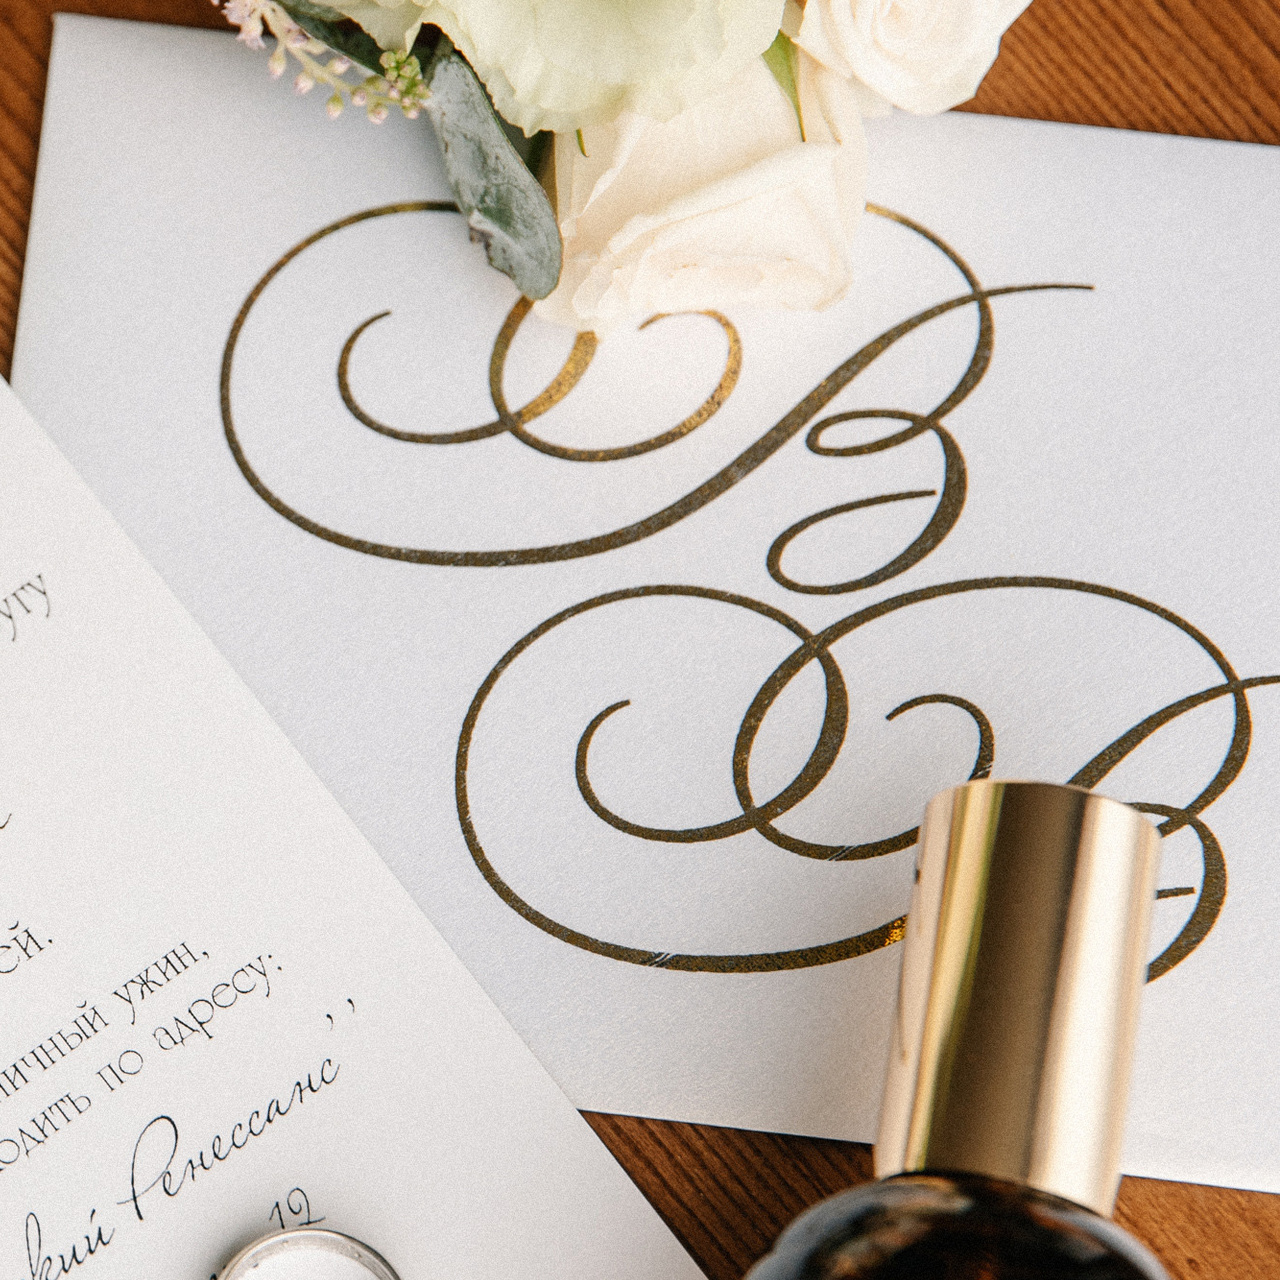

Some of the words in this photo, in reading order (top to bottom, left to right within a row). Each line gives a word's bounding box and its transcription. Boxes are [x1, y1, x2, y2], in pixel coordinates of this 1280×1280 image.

[96, 1048, 145, 1092] по
[153, 952, 284, 1052] адресу:
[113, 941, 212, 1026] ужин,
[268, 1186, 327, 1230] 12
